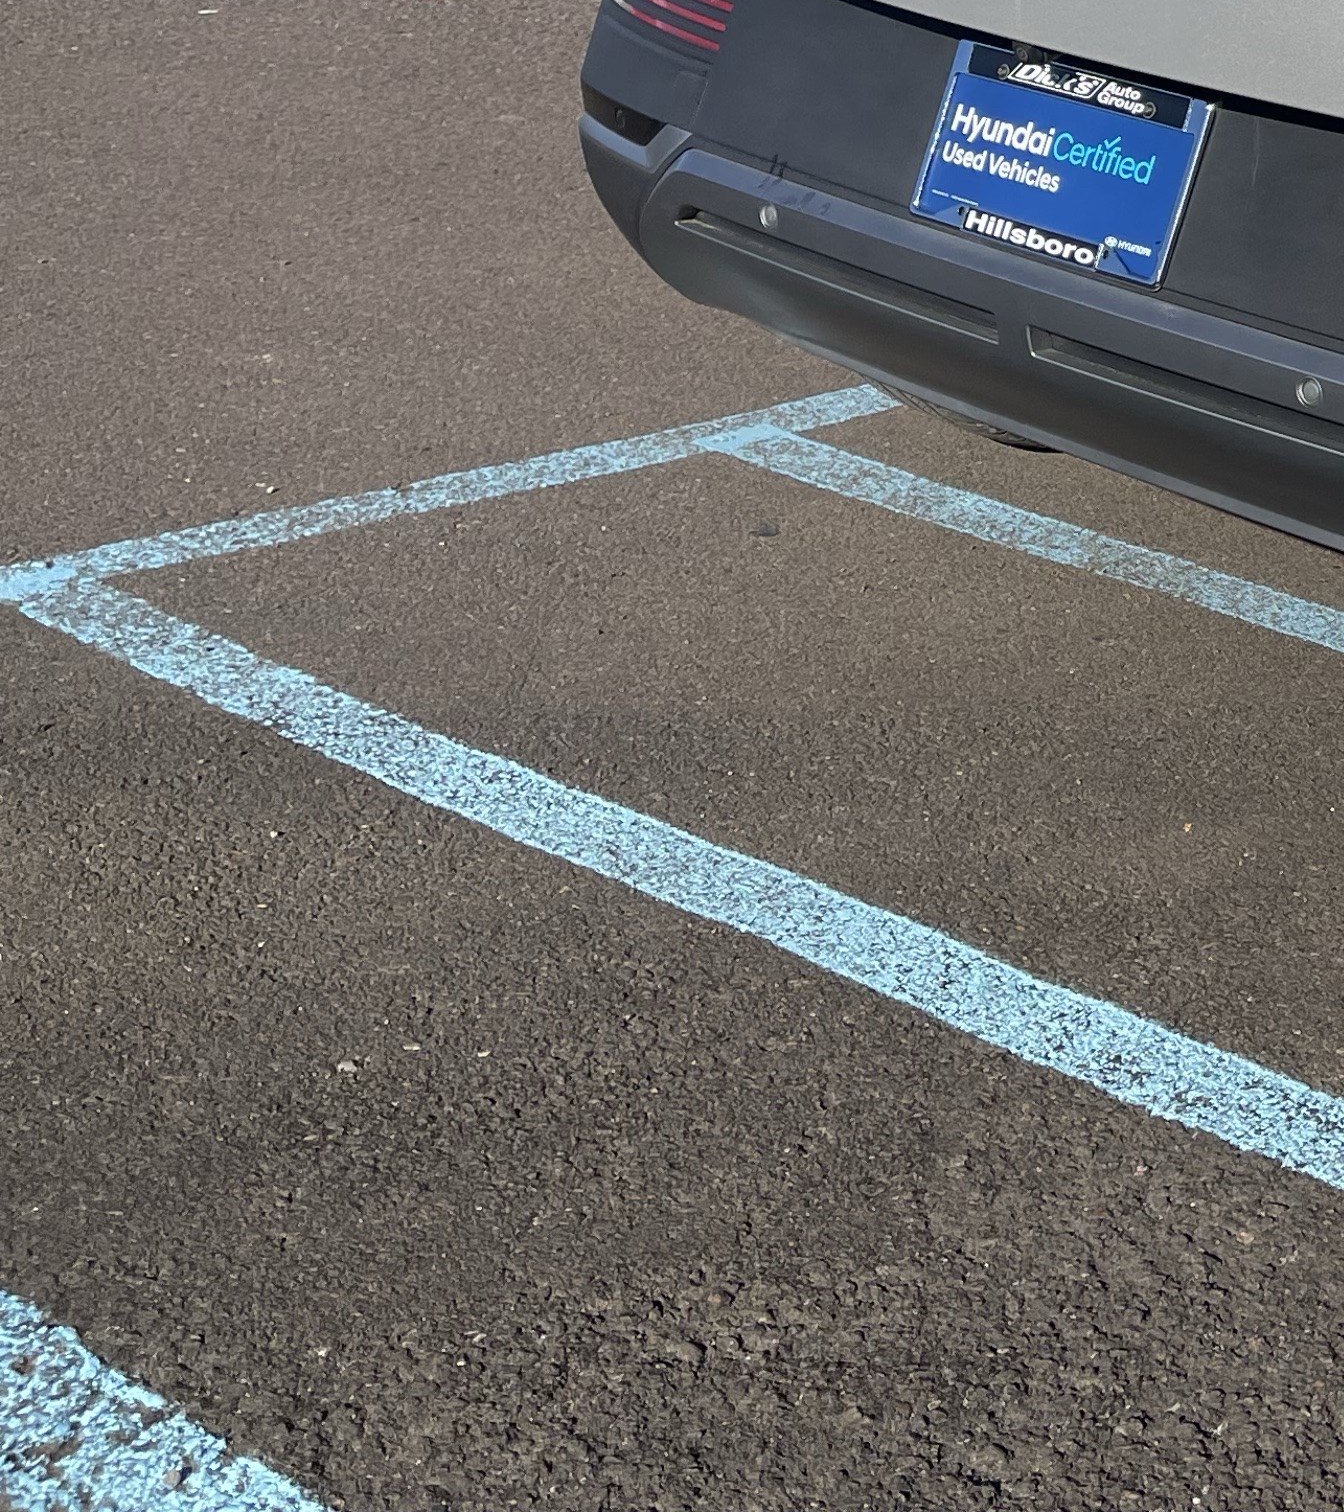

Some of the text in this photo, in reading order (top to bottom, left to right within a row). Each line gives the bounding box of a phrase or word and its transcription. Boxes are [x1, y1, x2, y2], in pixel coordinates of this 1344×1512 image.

[1102, 81, 1141, 101] Auto
[1096, 92, 1146, 115] Group
[942, 140, 1061, 193] Used Vehicles
[964, 209, 1096, 265] Hillsboro
[1117, 239, 1152, 257] HYUNDAI
